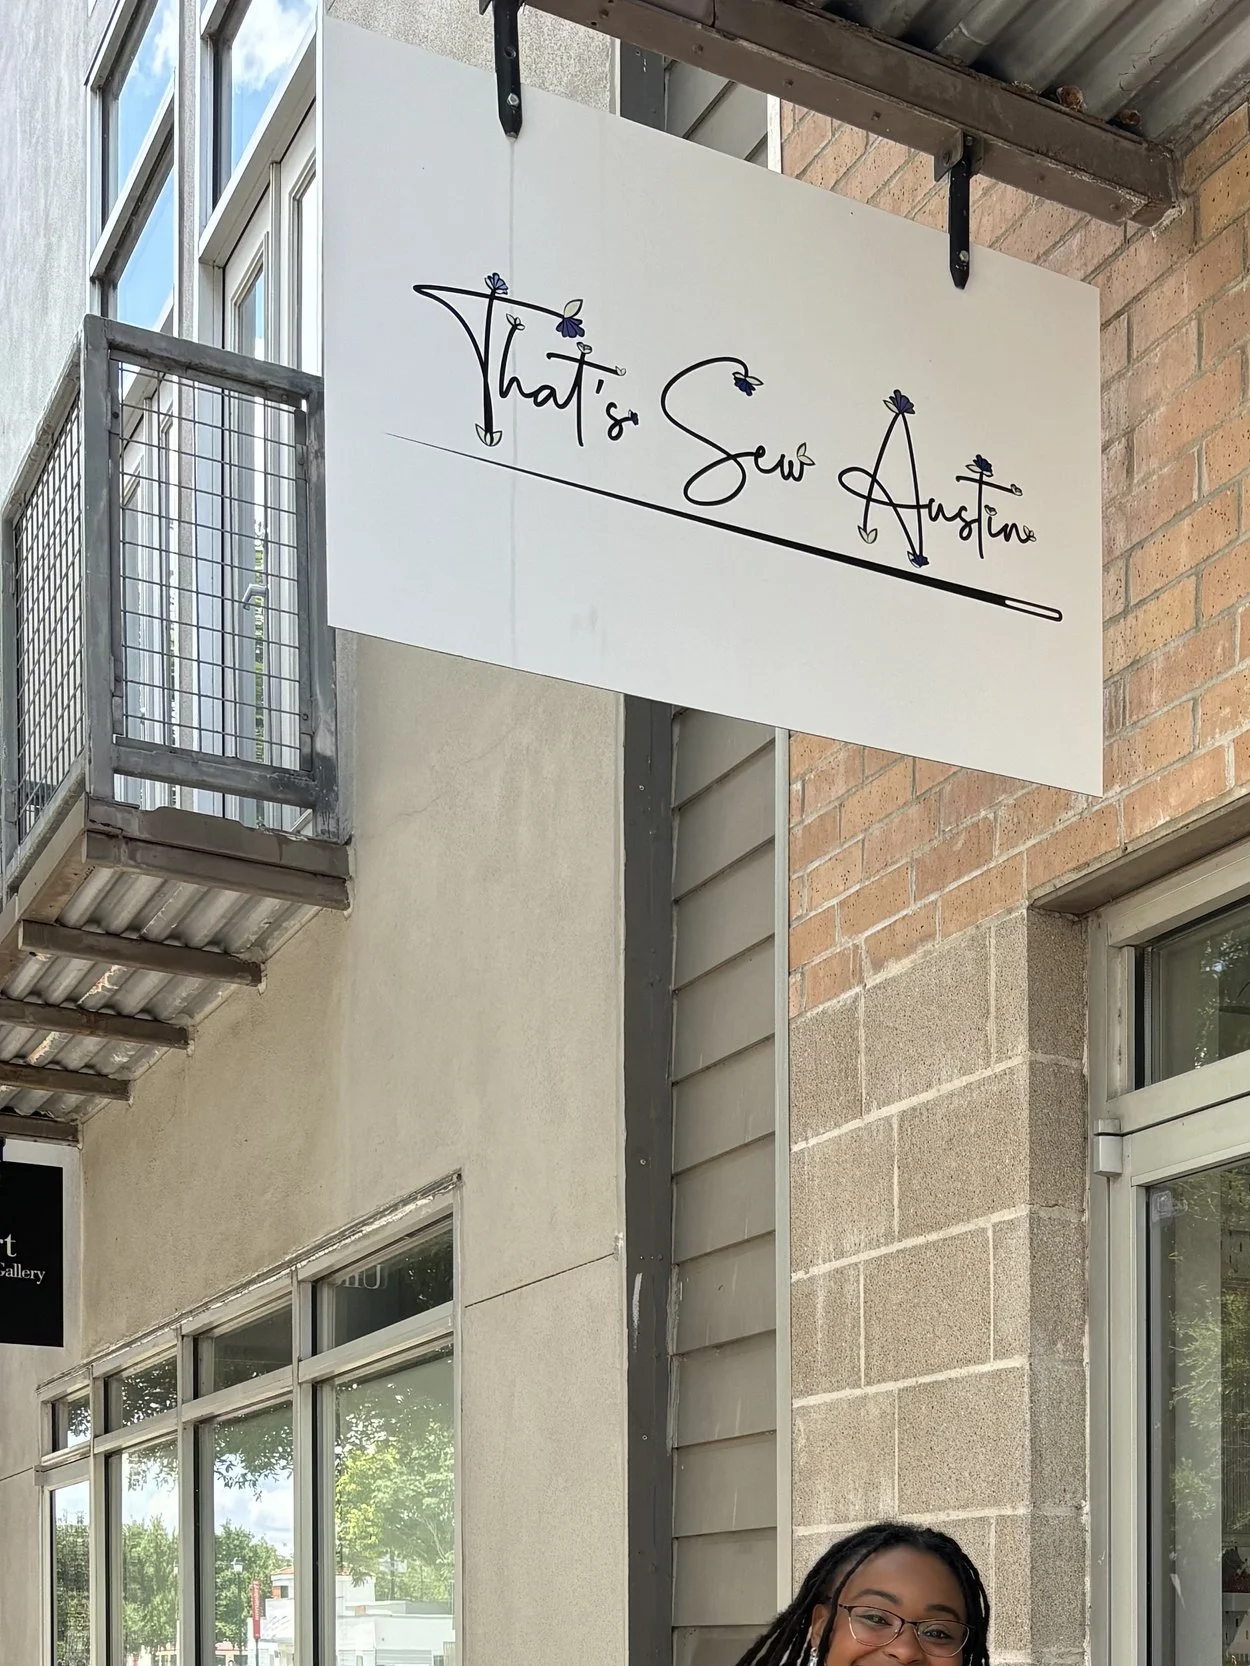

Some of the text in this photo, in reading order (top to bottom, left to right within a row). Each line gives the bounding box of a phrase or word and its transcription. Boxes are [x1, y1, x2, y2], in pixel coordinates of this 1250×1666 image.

[412, 272, 1038, 568] That's Sew Austin
